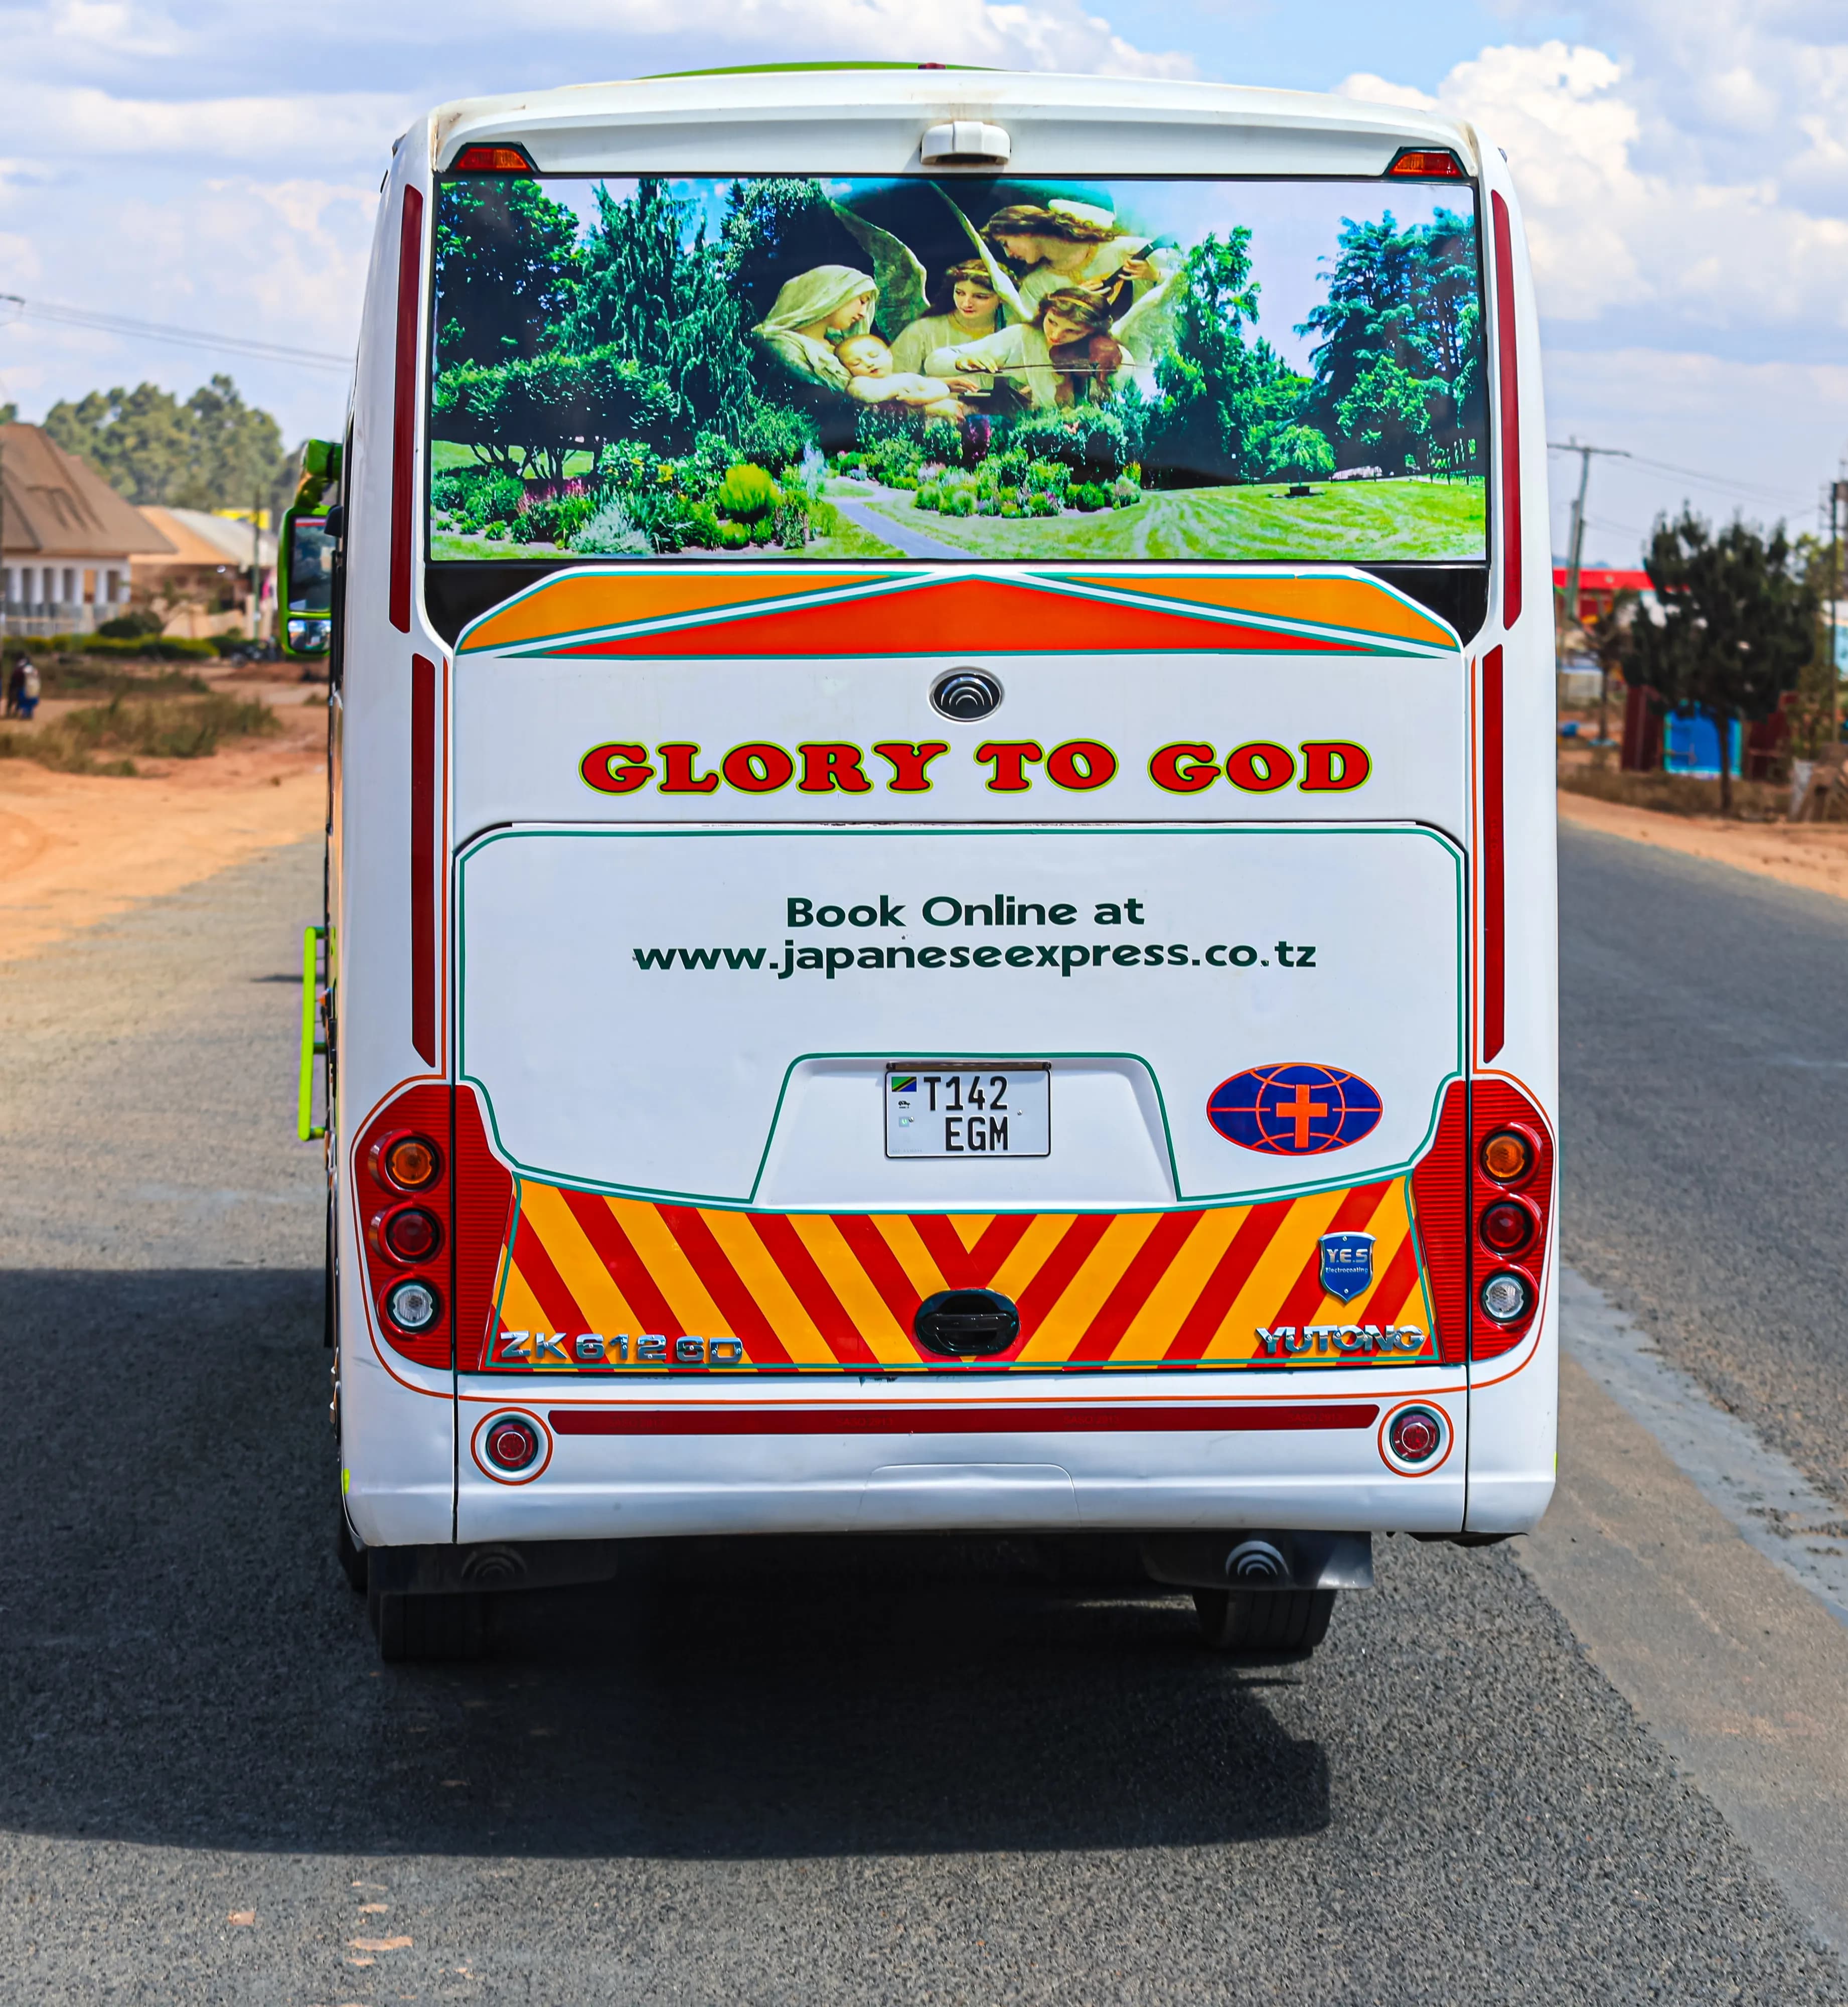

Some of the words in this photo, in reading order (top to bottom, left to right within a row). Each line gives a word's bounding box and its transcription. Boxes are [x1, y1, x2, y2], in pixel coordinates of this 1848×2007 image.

[578, 740, 951, 796] GLORY
[973, 738, 1120, 794] TO
[1147, 740, 1372, 796] GOD
[787, 895, 906, 927] Book
[922, 894, 1077, 926] Online
[1094, 898, 1145, 925] at
[634, 940, 1316, 979] www.japaneseexpress.co.tz
[923, 1076, 1008, 1111] T142
[945, 1116, 1008, 1151] EGM
[1255, 1325, 1426, 1354] YUTONG
